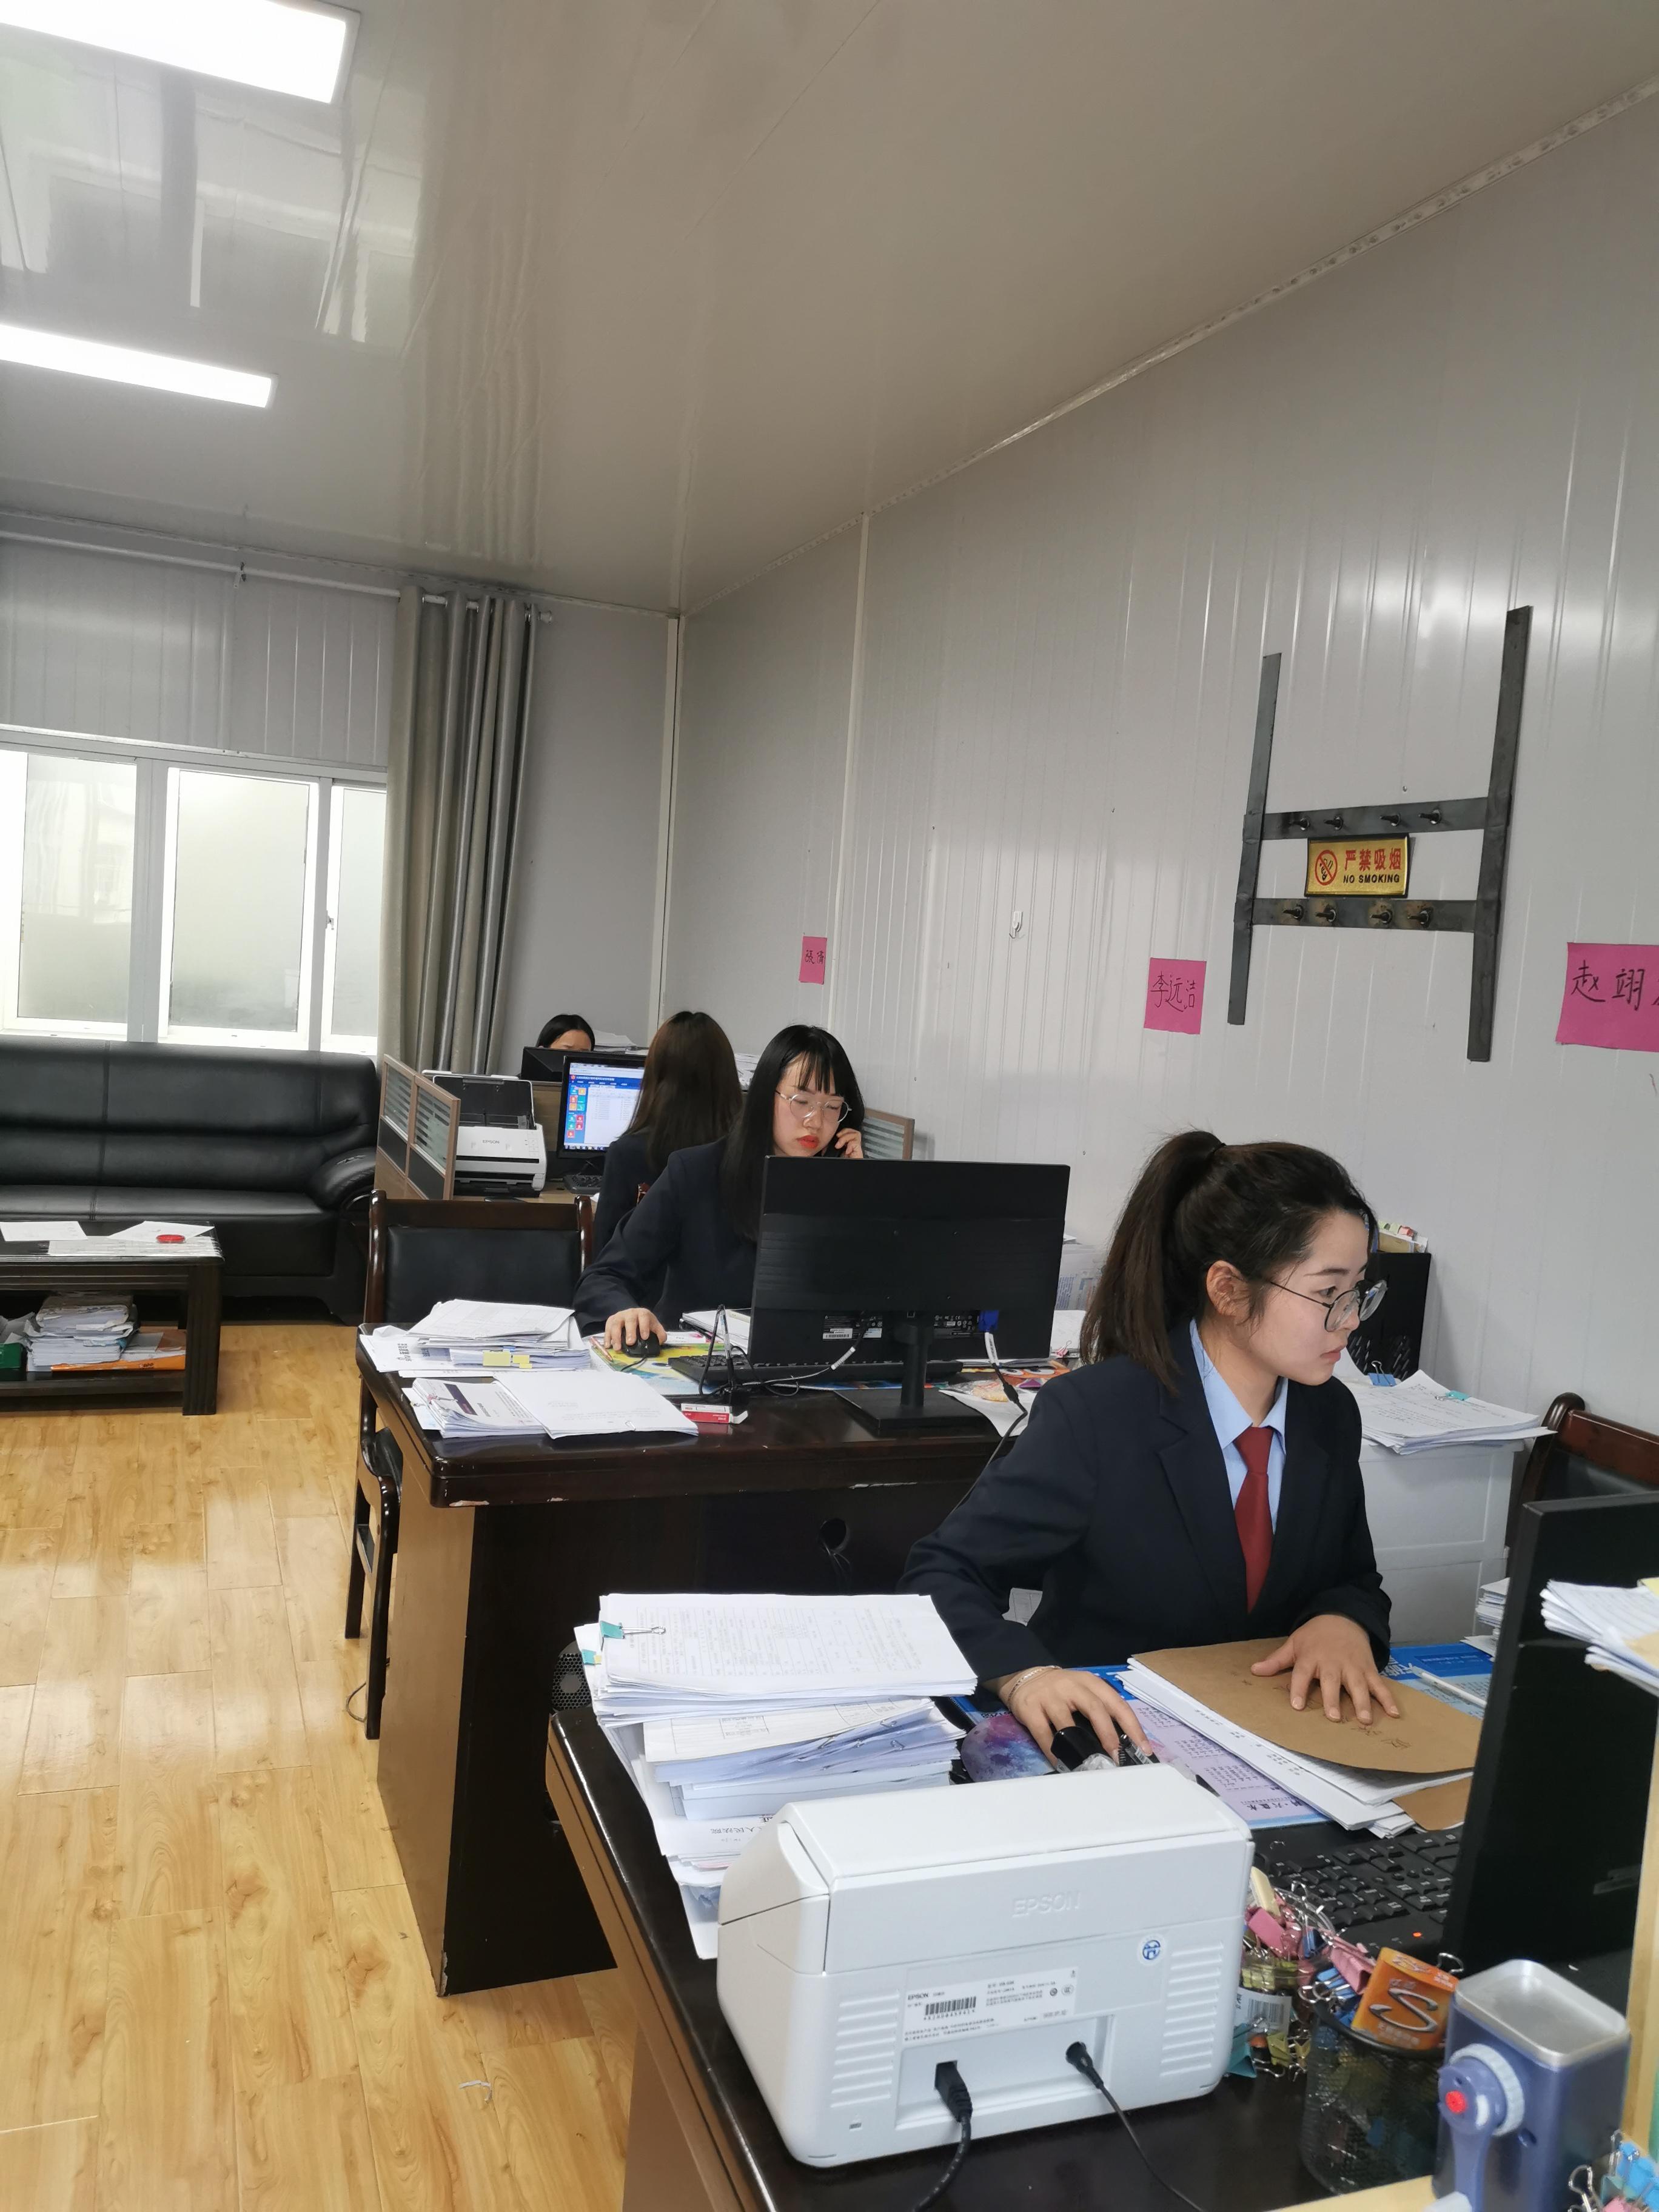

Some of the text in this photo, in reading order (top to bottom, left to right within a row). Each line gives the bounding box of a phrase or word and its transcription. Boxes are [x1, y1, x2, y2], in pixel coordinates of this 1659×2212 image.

[1344, 848, 1401, 871] 严禁吸烟
[1343, 874, 1399, 883] NO SMOKING
[1150, 970, 1196, 1013] 李远洁
[1570, 959, 1659, 1011] 赵翊
[1011, 1890, 1082, 1918] EPSON
